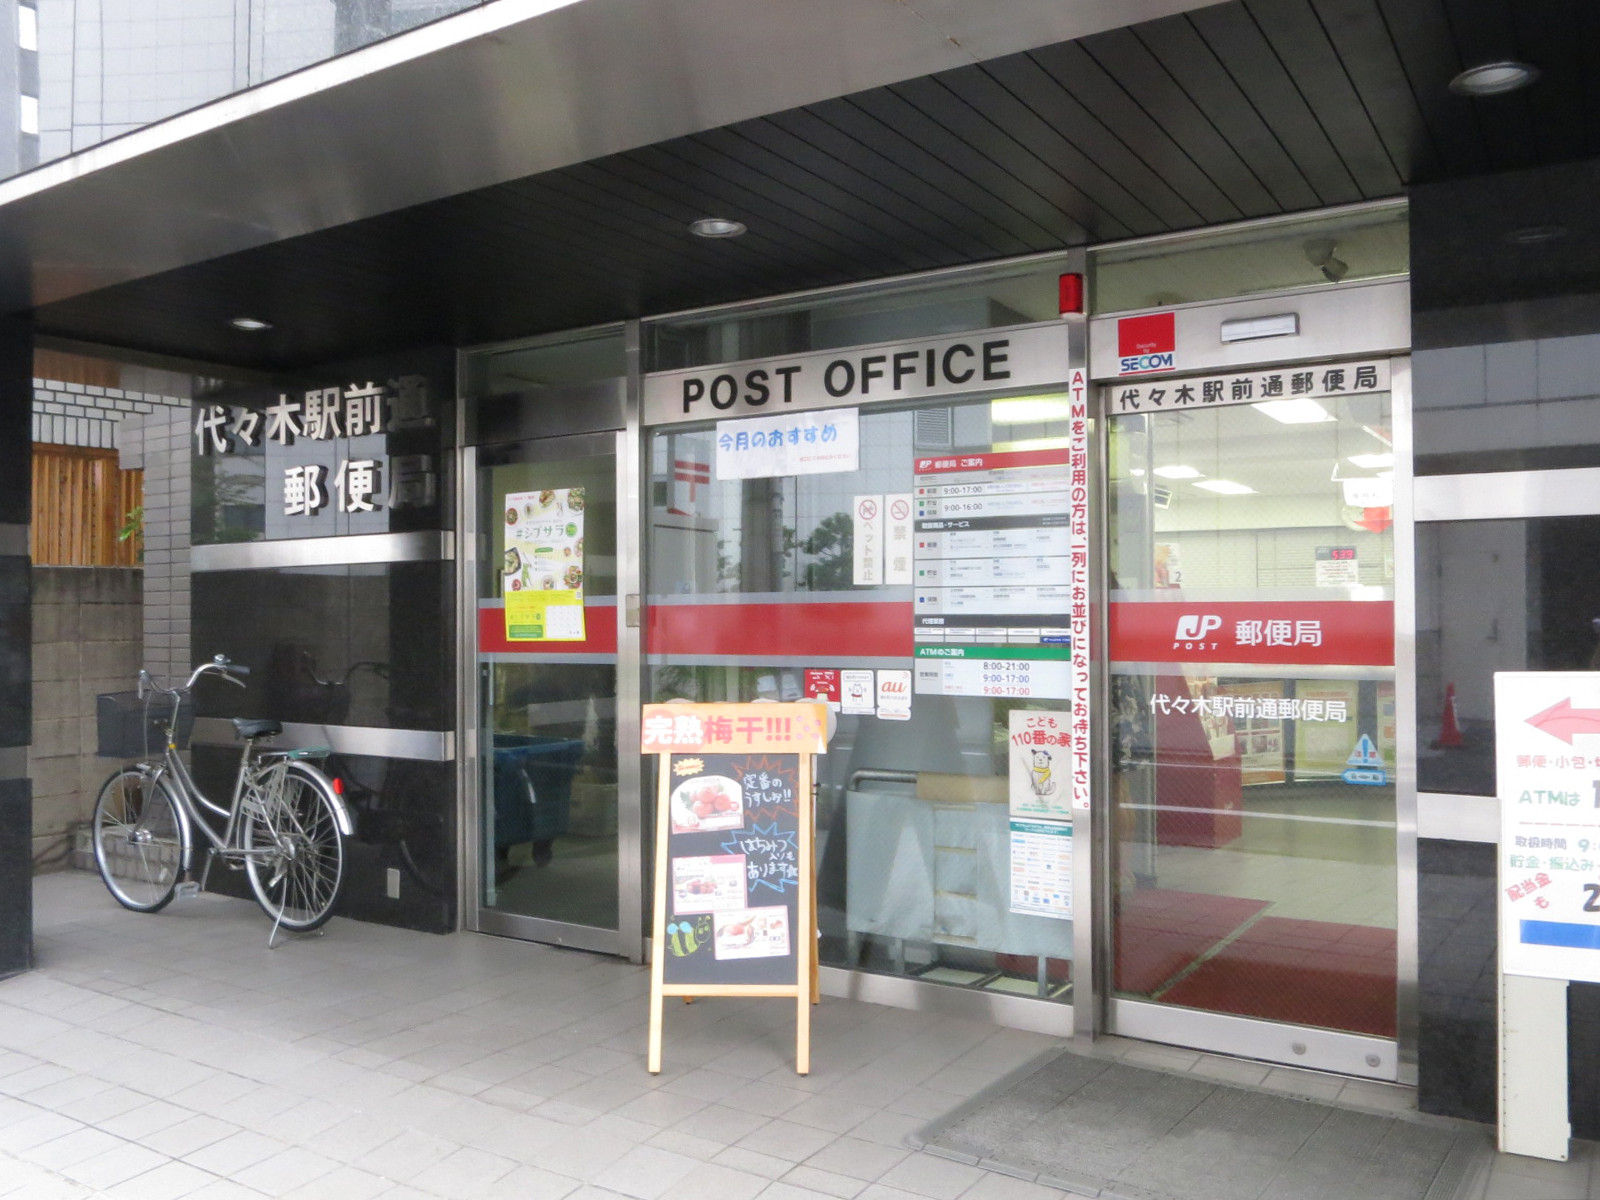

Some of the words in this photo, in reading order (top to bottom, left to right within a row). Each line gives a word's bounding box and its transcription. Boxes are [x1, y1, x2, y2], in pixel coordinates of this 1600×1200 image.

[1121, 353, 1173, 373] SECOM
[682, 365, 802, 414] POST
[823, 339, 1012, 398] OFFICE
[1119, 364, 1379, 411] 代々木駅前通郵便局
[717, 423, 838, 453] 今月のおすすめ
[943, 485, 983, 495] 9:00-17:00
[943, 503, 983, 512] 9:00-16:00
[1070, 371, 1090, 810] ATMをご利用の方は、一列にお並びになってお待ち下さい。
[1175, 614, 1222, 641] JP
[1234, 619, 1323, 648] 郵便局
[1172, 642, 1219, 651] POST
[983, 661, 1031, 671] 8:00-21:00
[880, 680, 907, 694] au
[982, 674, 1031, 683] 9:00-17:00
[983, 686, 1031, 696] 9:00-17:00
[1149, 693, 1348, 724] 代々木駅前通郵便局
[1026, 716, 1058, 729] こども
[1011, 729, 1072, 748] 110番の家
[743, 771, 783, 791] 定番の
[1518, 789, 1581, 807] ATMは
[739, 836, 788, 855] はちみつ
[1515, 835, 1567, 850] 取扱時間
[1505, 872, 1552, 903] 配当金
